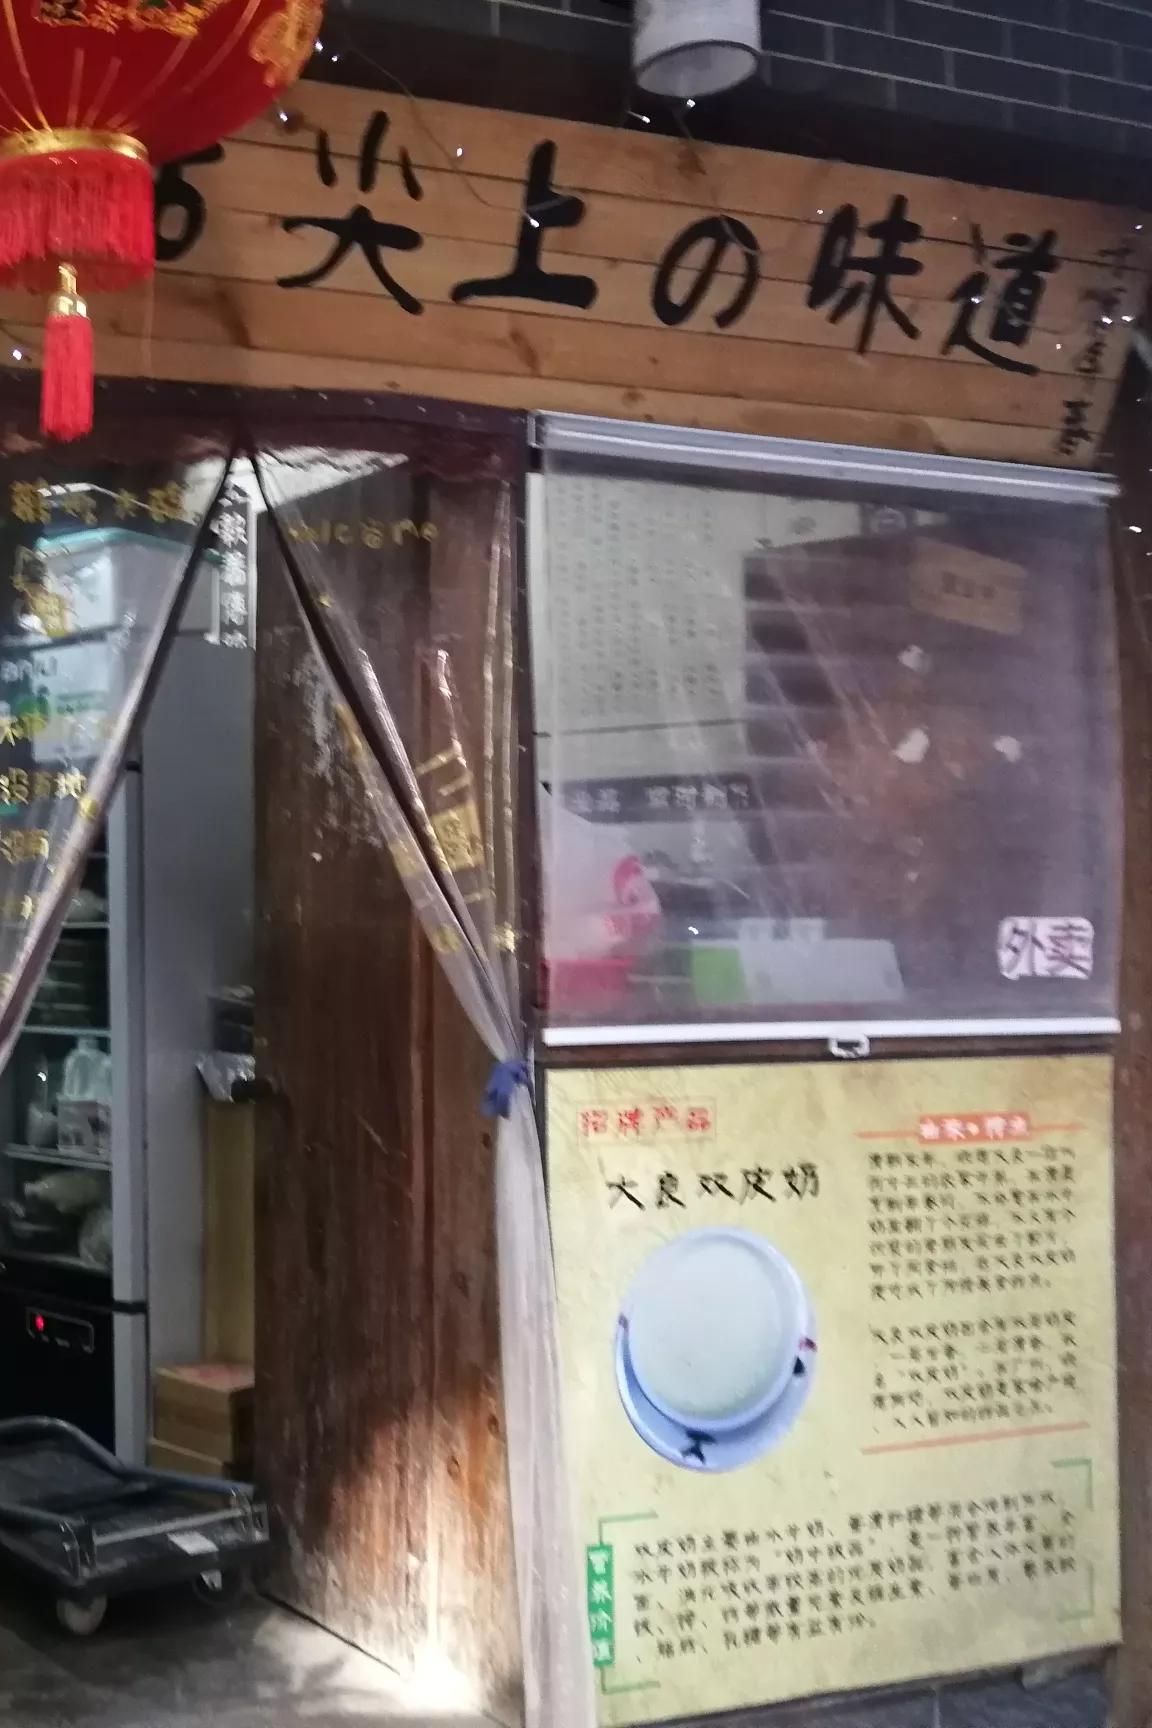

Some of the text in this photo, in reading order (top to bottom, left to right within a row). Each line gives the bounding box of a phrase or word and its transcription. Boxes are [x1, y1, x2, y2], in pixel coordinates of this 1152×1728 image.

[1003, 921, 1091, 977] 外卖
[605, 1163, 820, 1212] 大良双皮奶
